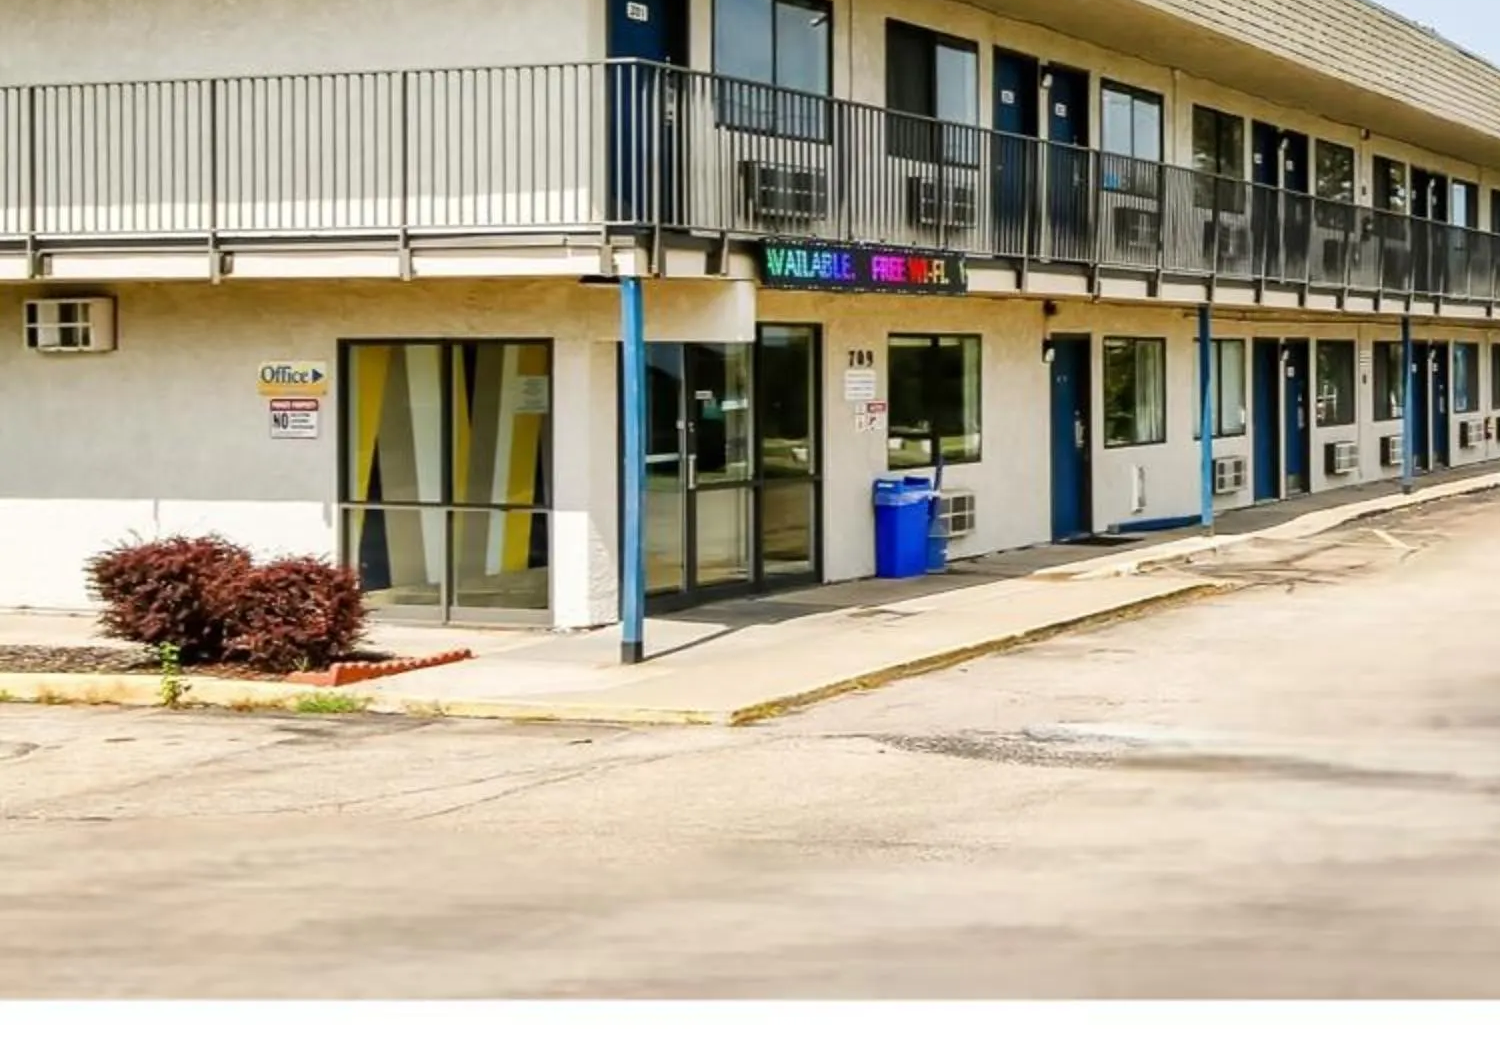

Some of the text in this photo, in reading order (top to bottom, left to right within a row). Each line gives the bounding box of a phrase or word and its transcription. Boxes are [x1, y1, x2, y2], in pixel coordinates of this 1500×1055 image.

[872, 255, 906, 283] FREE
[847, 349, 874, 368] 709
[261, 365, 310, 384] Office
